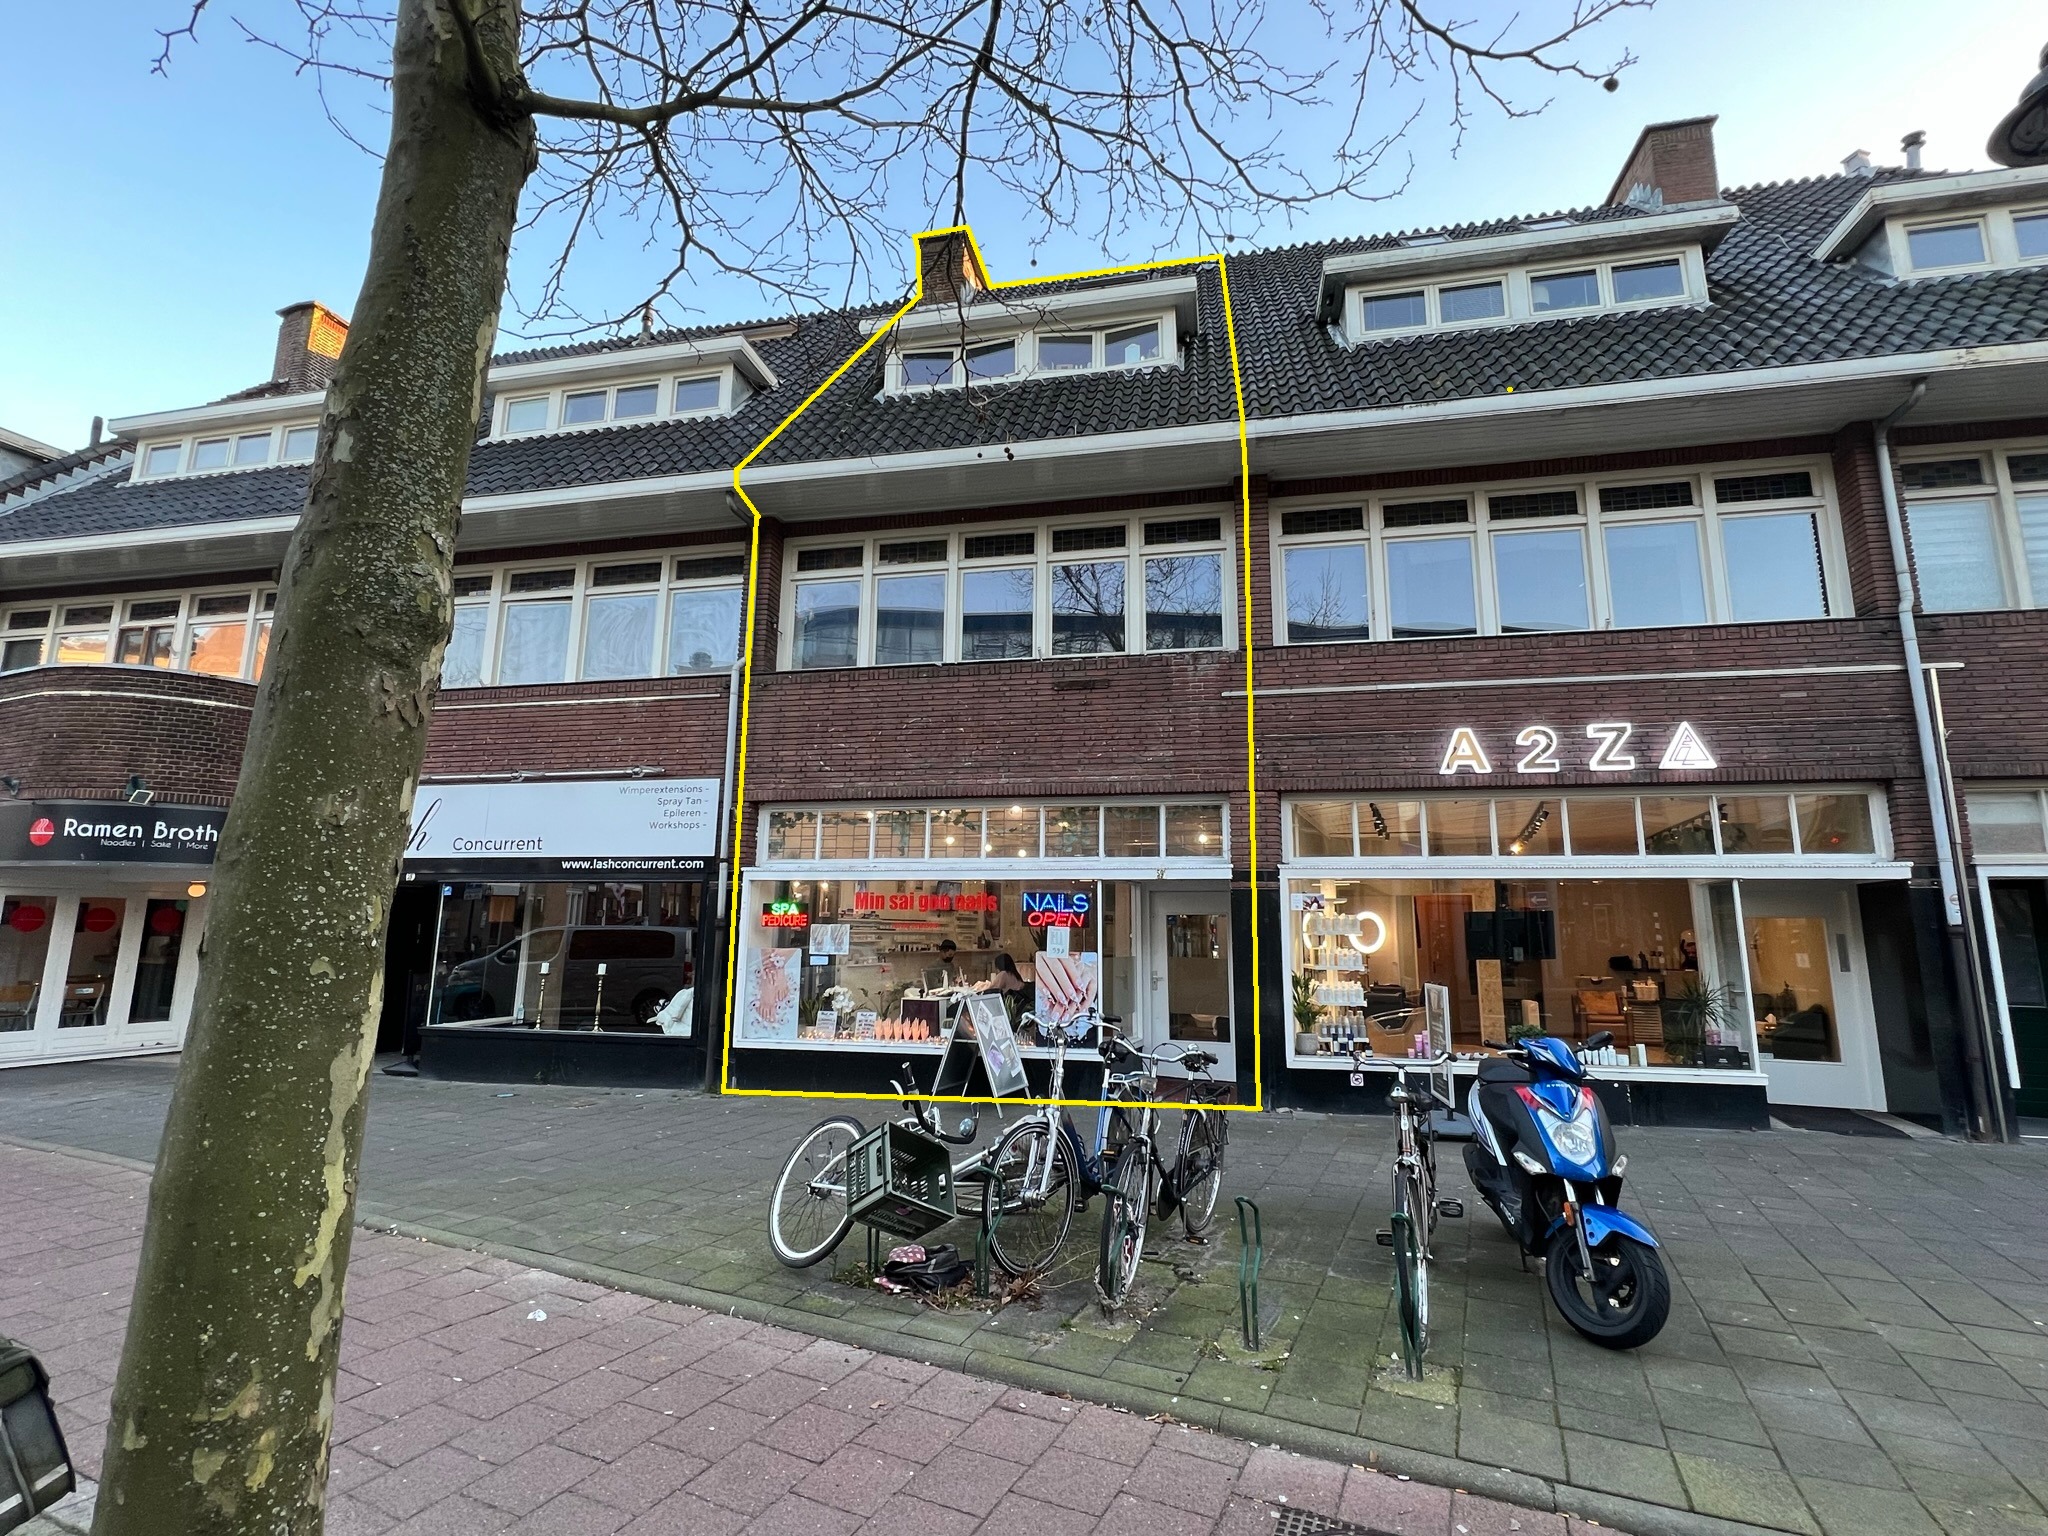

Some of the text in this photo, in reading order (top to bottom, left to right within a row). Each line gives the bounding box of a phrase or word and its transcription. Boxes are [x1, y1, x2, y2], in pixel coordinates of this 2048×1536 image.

[619, 785, 703, 796] Wimperextensions
[657, 797, 684, 807] Spray
[686, 797, 702, 806] Tan
[663, 809, 701, 818] Epileren
[63, 818, 143, 838] Ramen
[649, 820, 701, 831] Workshops
[101, 839, 136, 847] Noodles
[150, 840, 172, 848] Sake
[186, 842, 209, 850] More
[452, 836, 543, 851] Concurrent
[561, 858, 705, 869] www.lashconcurrent.com
[854, 892, 885, 911] Min
[888, 892, 915, 911] sai
[953, 891, 998, 912] nails
[1023, 893, 1089, 912] NAILS
[771, 903, 799, 915] SPA
[762, 914, 808, 926] PEDICURE
[1028, 912, 1084, 927] OPEN
